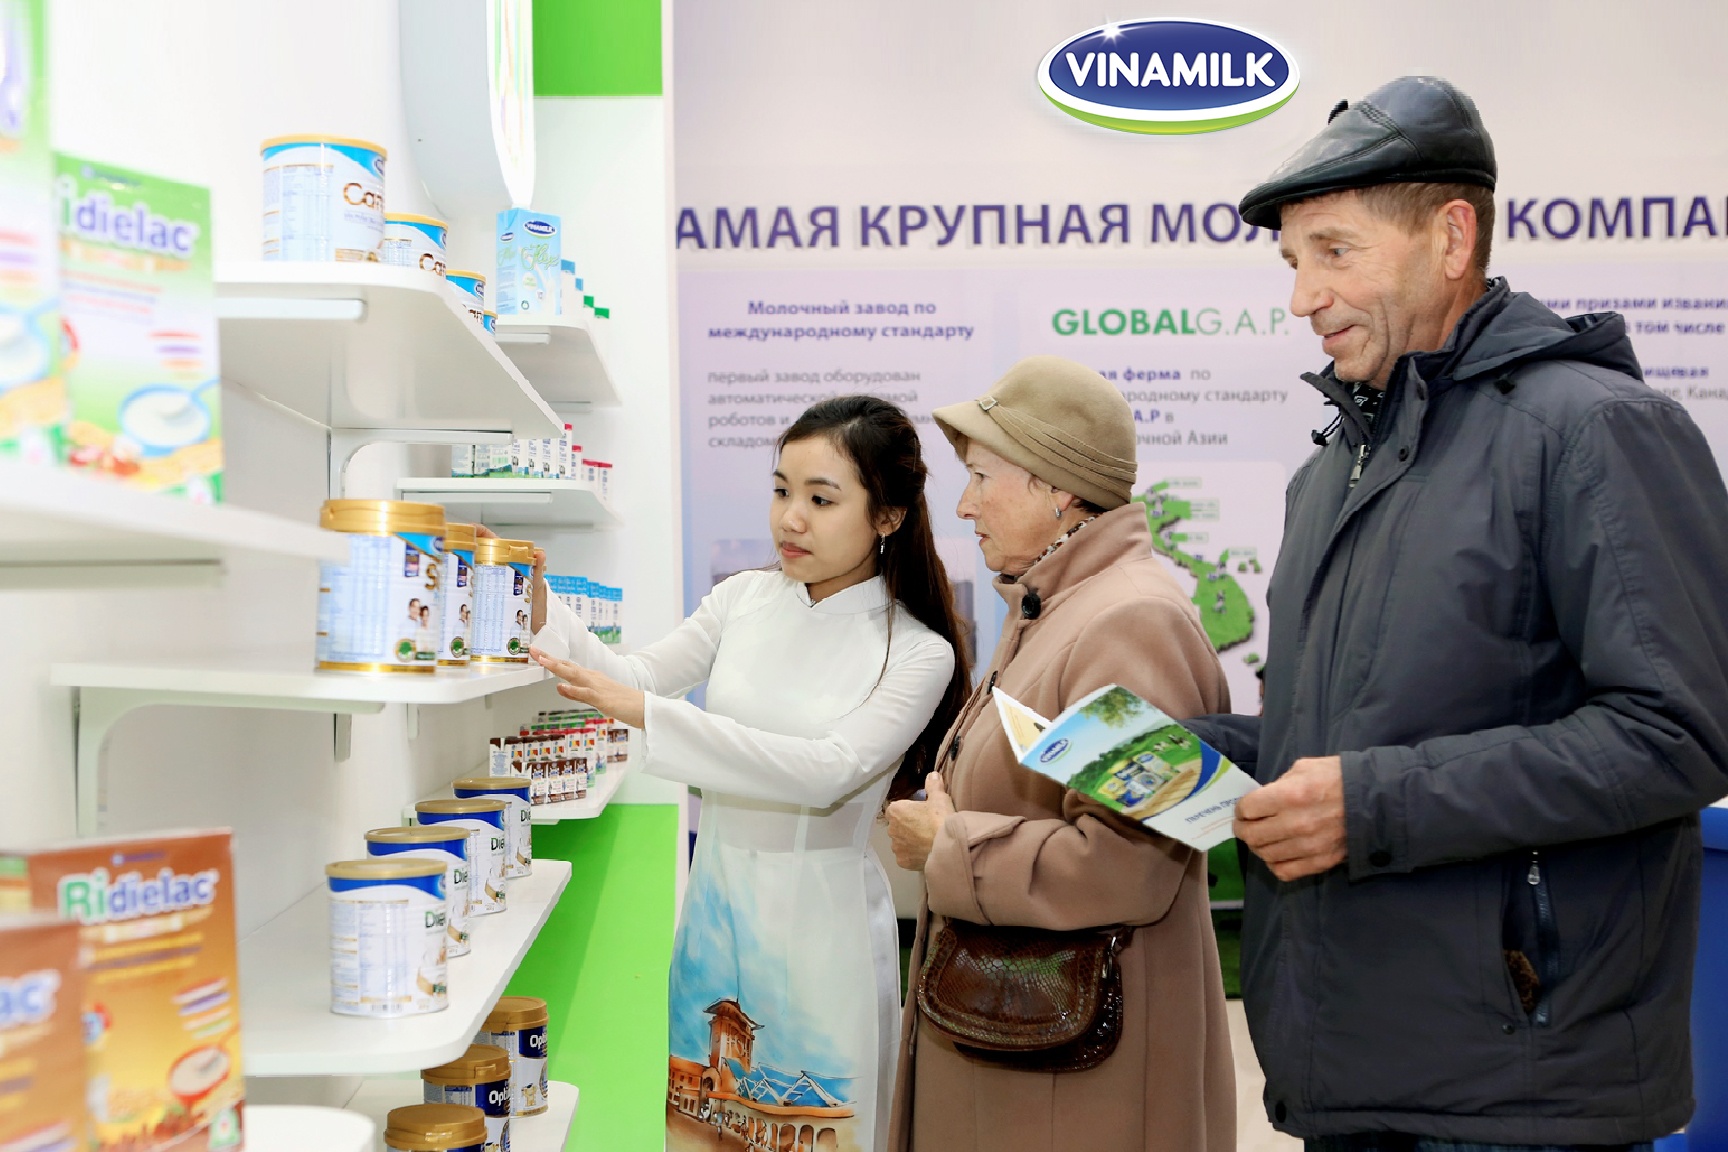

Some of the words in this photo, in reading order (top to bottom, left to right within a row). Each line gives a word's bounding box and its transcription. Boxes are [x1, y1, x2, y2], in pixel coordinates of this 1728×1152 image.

[1065, 52, 1276, 89] VINAMILK
[860, 204, 1131, 247] КРУПНАЯ
[1508, 196, 1728, 240] КОМПА
[748, 300, 850, 315] Молочный
[854, 302, 909, 317] завод
[914, 302, 937, 315] по
[708, 326, 877, 341] международному
[881, 324, 975, 341] стандарту
[708, 369, 770, 384] первый
[774, 371, 821, 384] завод
[823, 369, 921, 384] оборудован
[1123, 366, 1181, 382] ферма
[1190, 369, 1211, 380] по
[1204, 389, 1288, 403] стандарту
[708, 412, 775, 427] роботов
[1187, 430, 1228, 445] Азии
[62, 869, 212, 918] Ridielac
